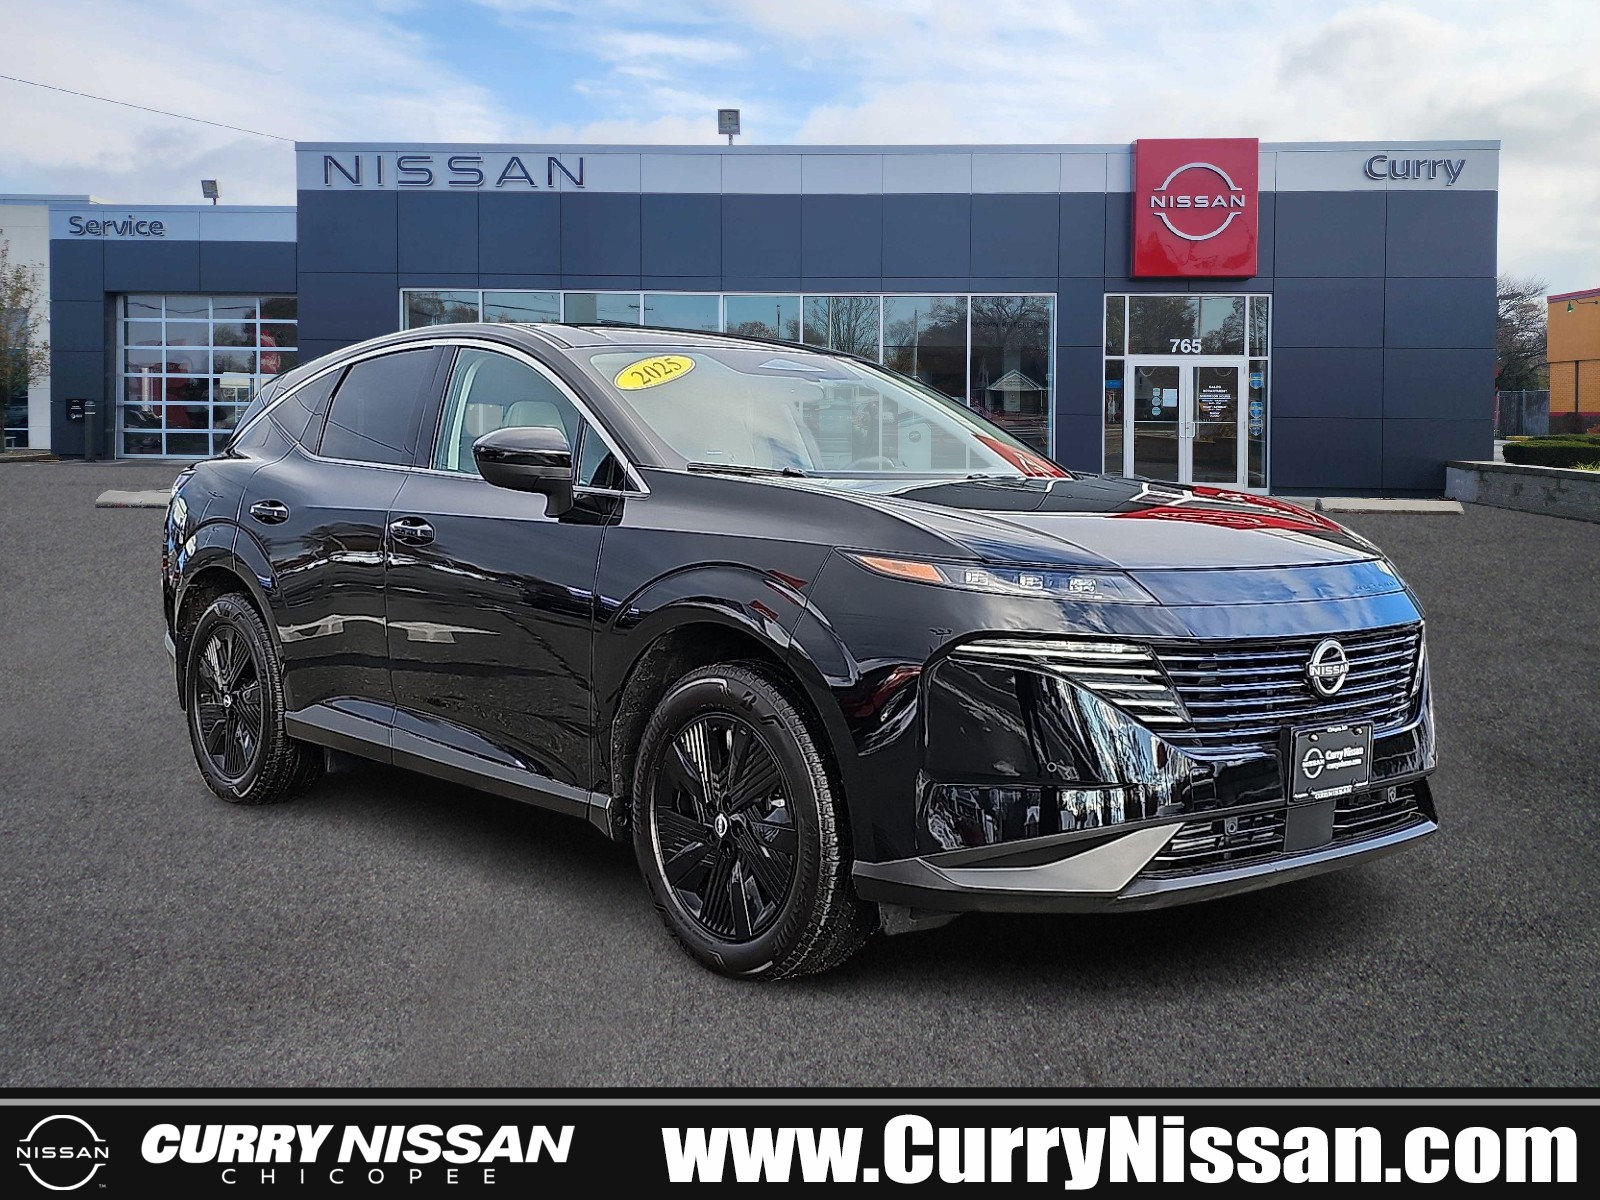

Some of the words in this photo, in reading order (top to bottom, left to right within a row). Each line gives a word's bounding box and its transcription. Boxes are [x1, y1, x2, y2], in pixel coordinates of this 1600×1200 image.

[323, 155, 585, 188] NISSAN
[1364, 154, 1466, 186] Curry
[1150, 194, 1246, 208] NISSAN
[68, 214, 165, 236] Service
[1169, 338, 1202, 354] 765
[630, 357, 682, 385] 2025
[1309, 662, 1350, 677] NISSAN
